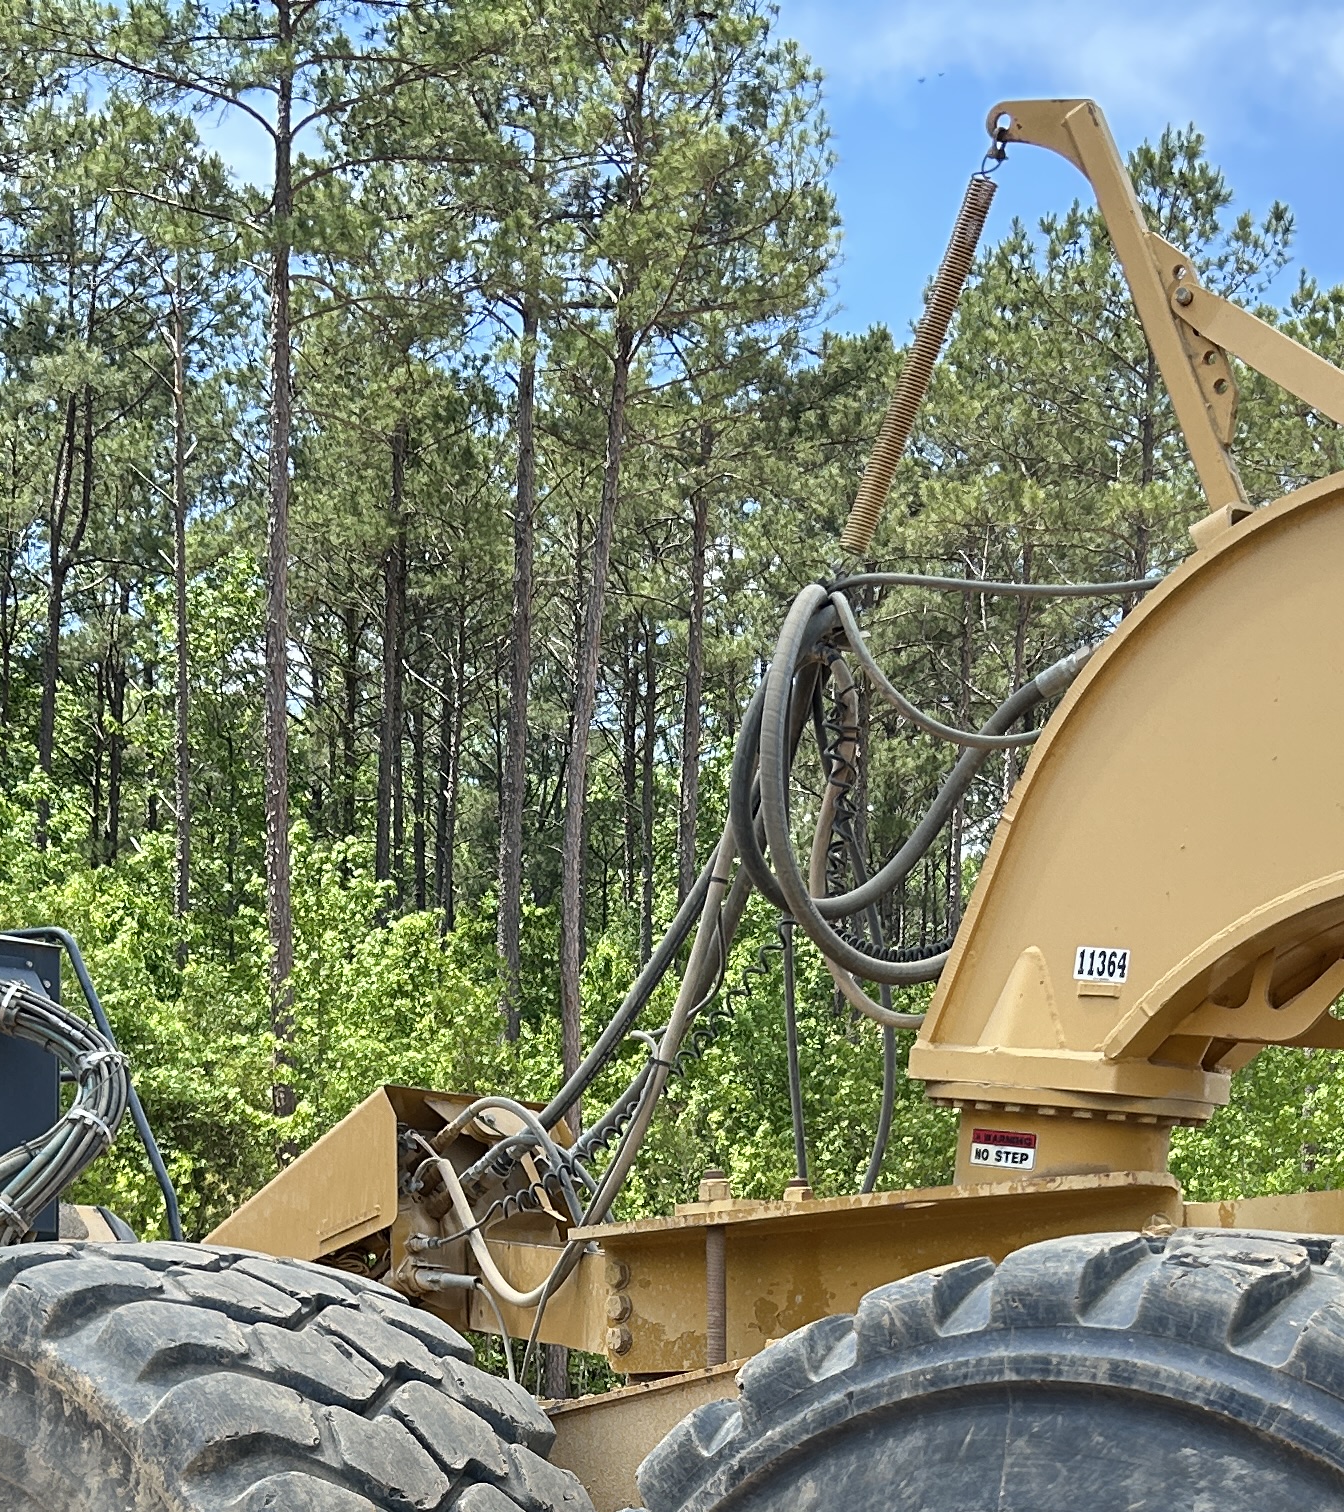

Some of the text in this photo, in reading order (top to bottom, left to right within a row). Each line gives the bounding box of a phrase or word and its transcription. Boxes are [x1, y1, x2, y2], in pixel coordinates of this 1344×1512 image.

[1077, 949, 1128, 978] 11364
[984, 1132, 1032, 1147] WARNING
[975, 1147, 1029, 1164] NO STEP
